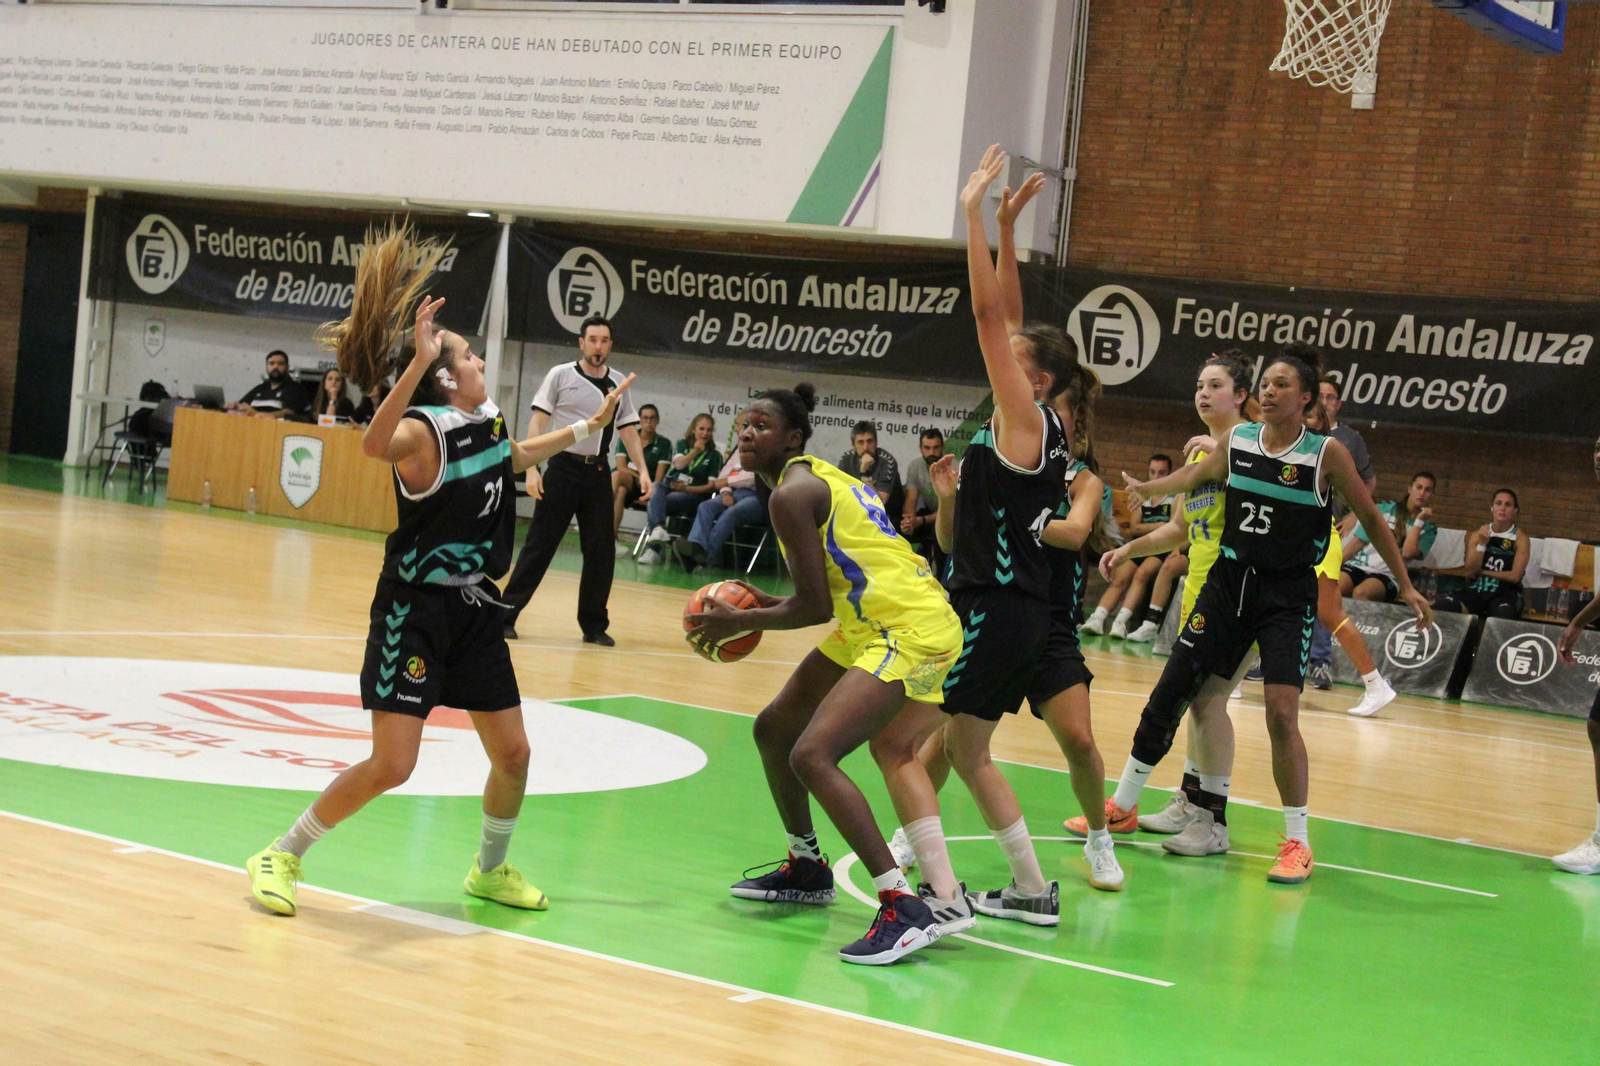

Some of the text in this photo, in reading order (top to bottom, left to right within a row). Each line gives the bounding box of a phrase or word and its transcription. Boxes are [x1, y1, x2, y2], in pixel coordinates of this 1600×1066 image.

[310, 32, 842, 60] JUGADORES DE CANTERA QUE HAN DEBUTADO CON EL PRIMER EQUIPO
[353, 86, 378, 95] Antonio
[420, 89, 442, 100] Miguel
[482, 92, 502, 100] Jesús
[504, 92, 528, 100] Lázaro
[533, 92, 560, 102] Manolo
[561, 94, 584, 104] Bazán
[590, 95, 618, 104] Antonio
[619, 96, 648, 106] Benítez
[653, 97, 678, 108] Rafael
[679, 98, 706, 108] Ibáñez
[711, 100, 730, 109] José
[425, 72, 445, 82] Pedro
[447, 72, 470, 83] García
[474, 74, 506, 84] Armando
[507, 75, 534, 88] Nogués
[559, 77, 586, 87] Antonio
[588, 78, 611, 88] Martín
[617, 78, 640, 89] Emilio
[641, 80, 666, 90] Osuna
[672, 80, 692, 91] Paco
[693, 81, 724, 92] Cabello
[729, 83, 755, 96] Miguel
[756, 83, 780, 94] Pérez
[441, 106, 462, 115] David
[478, 107, 504, 117] Manolo
[505, 108, 526, 118] Pérez
[531, 109, 555, 119] Rubén
[556, 110, 576, 122] Mayo
[582, 111, 616, 124] Alejandro
[640, 114, 670, 124] Germán
[672, 115, 700, 125] Gabriel
[706, 116, 728, 127] Manu
[729, 117, 758, 128] Gómez
[436, 122, 465, 134] Augusto
[488, 123, 508, 134] Pablo
[509, 124, 540, 136] Almazán
[546, 126, 570, 136] Carlos
[581, 128, 606, 139] Cobos
[611, 129, 632, 142] Pepe
[632, 130, 656, 141] Pozas
[660, 132, 688, 142] Alberto
[690, 133, 708, 144] Díaz
[713, 132, 732, 144] Álex
[732, 135, 762, 146] Abrines
[194, 224, 321, 264] Federación
[236, 269, 354, 309] de Balonc
[631, 259, 961, 314] Federación Andaluza
[682, 309, 892, 359] de Baloncesto
[1172, 297, 1594, 366] Federación Andaluza
[1327, 362, 1507, 415] loncesto
[708, 404, 715, 416] y
[717, 402, 731, 415] de
[808, 414, 855, 429] aprende
[886, 422, 909, 436] que
[944, 426, 977, 440] victo
[823, 394, 874, 412] alimenta
[878, 400, 902, 414] más
[906, 404, 928, 418] que
[932, 404, 942, 418] la
[1186, 496, 1215, 513] TENERIFE
[1239, 502, 1274, 534] 25
[397, 692, 422, 704] hummel
[109, 722, 236, 748] DEL
[241, 749, 351, 774] SO
